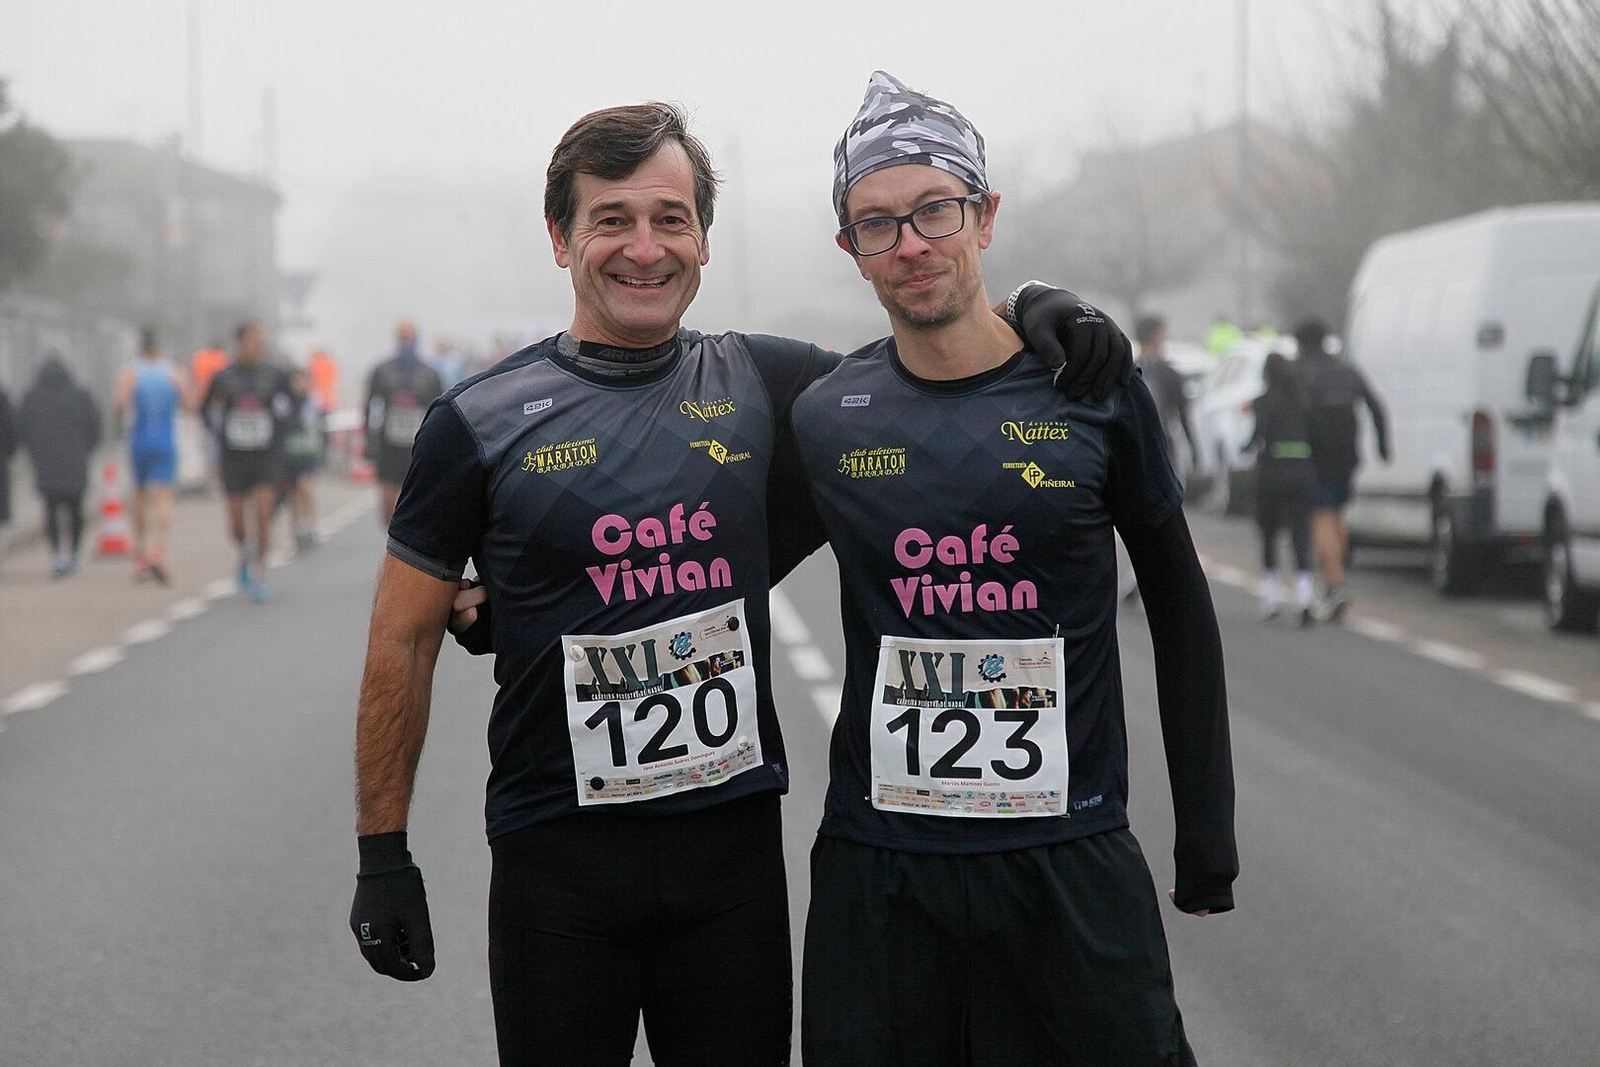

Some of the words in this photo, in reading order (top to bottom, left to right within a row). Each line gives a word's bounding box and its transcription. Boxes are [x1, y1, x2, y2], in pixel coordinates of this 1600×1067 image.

[525, 399, 551, 412] 42K
[680, 400, 736, 423] Nattex
[843, 396, 868, 406] 42K
[536, 443, 555, 453] club
[556, 437, 595, 450] atletismo
[1001, 421, 1069, 445] Nattex
[536, 444, 597, 468] MARATON
[725, 452, 752, 463] PIÑEIRAL
[850, 448, 867, 457] club
[868, 447, 906, 456] atletismo
[851, 453, 906, 472] MARATON
[1040, 479, 1077, 488] PIÑEIRAL
[591, 501, 717, 556] Café
[894, 523, 1020, 569] Café
[585, 552, 733, 606] Vivian
[890, 571, 1038, 619] Vivian
[583, 638, 662, 692] XXI
[898, 649, 966, 701] XXI
[948, 700, 965, 708] NADAL
[584, 677, 739, 768] 120
[885, 708, 1043, 781] 123
